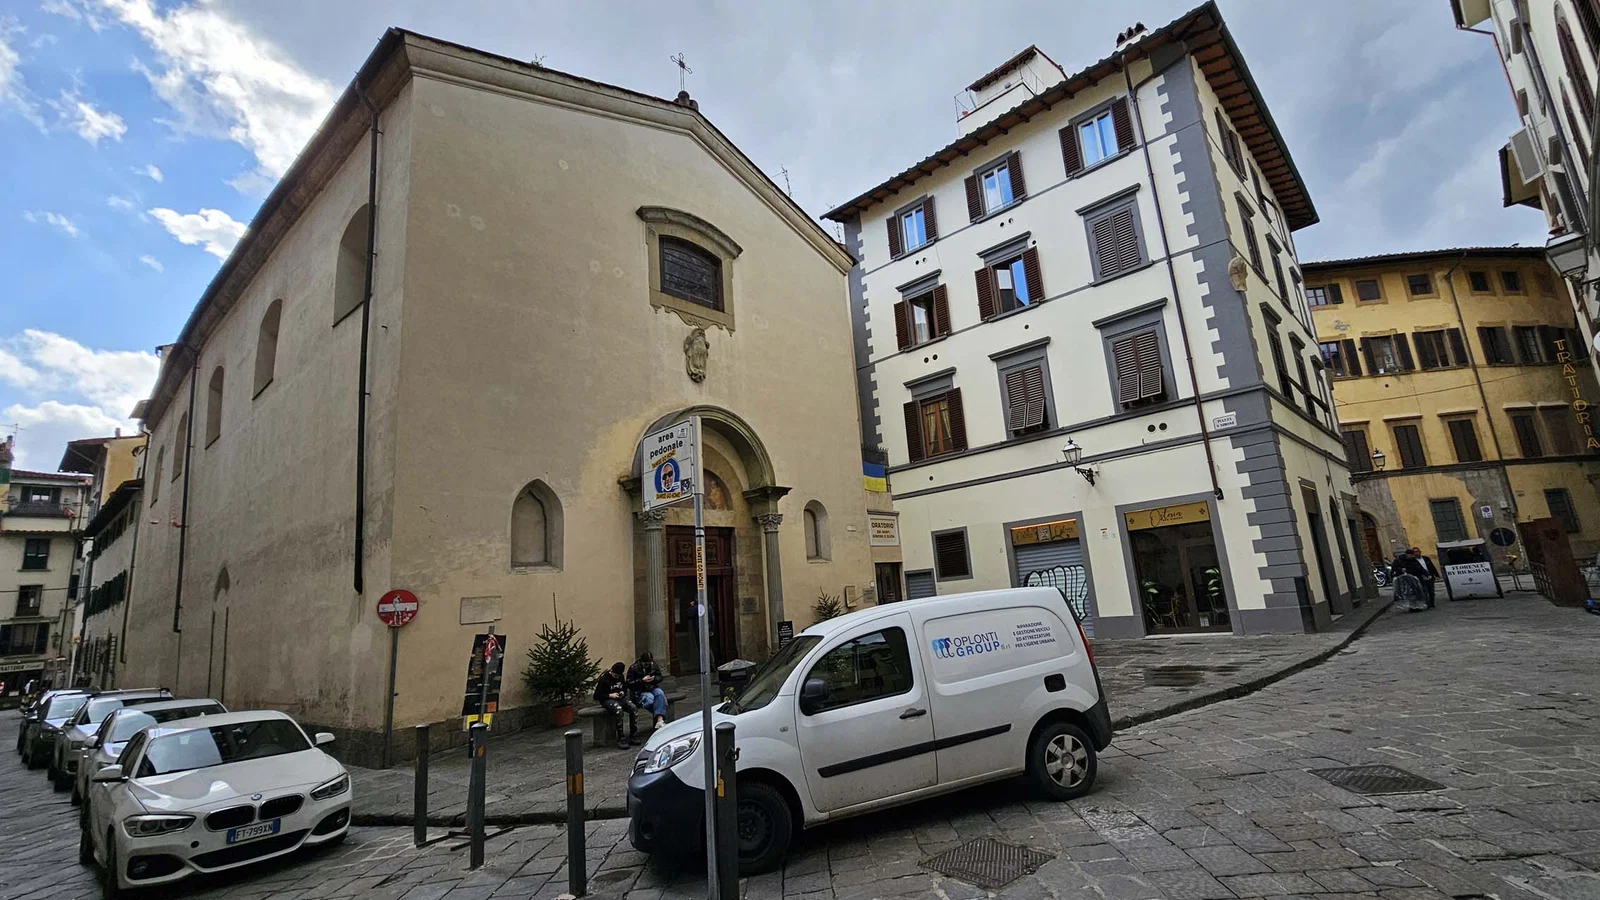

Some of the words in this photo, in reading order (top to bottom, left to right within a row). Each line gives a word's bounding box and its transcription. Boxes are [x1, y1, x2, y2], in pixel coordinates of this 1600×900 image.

[1553, 339, 1600, 449] TRATTORIA
[658, 431, 674, 443] area
[650, 440, 683, 459] pedonale
[1016, 621, 1043, 629] RIPARAZIONE
[953, 631, 999, 647] OPLONTI
[1022, 632, 1051, 640] ATTREZZATURE
[956, 641, 1000, 657] GROUP
